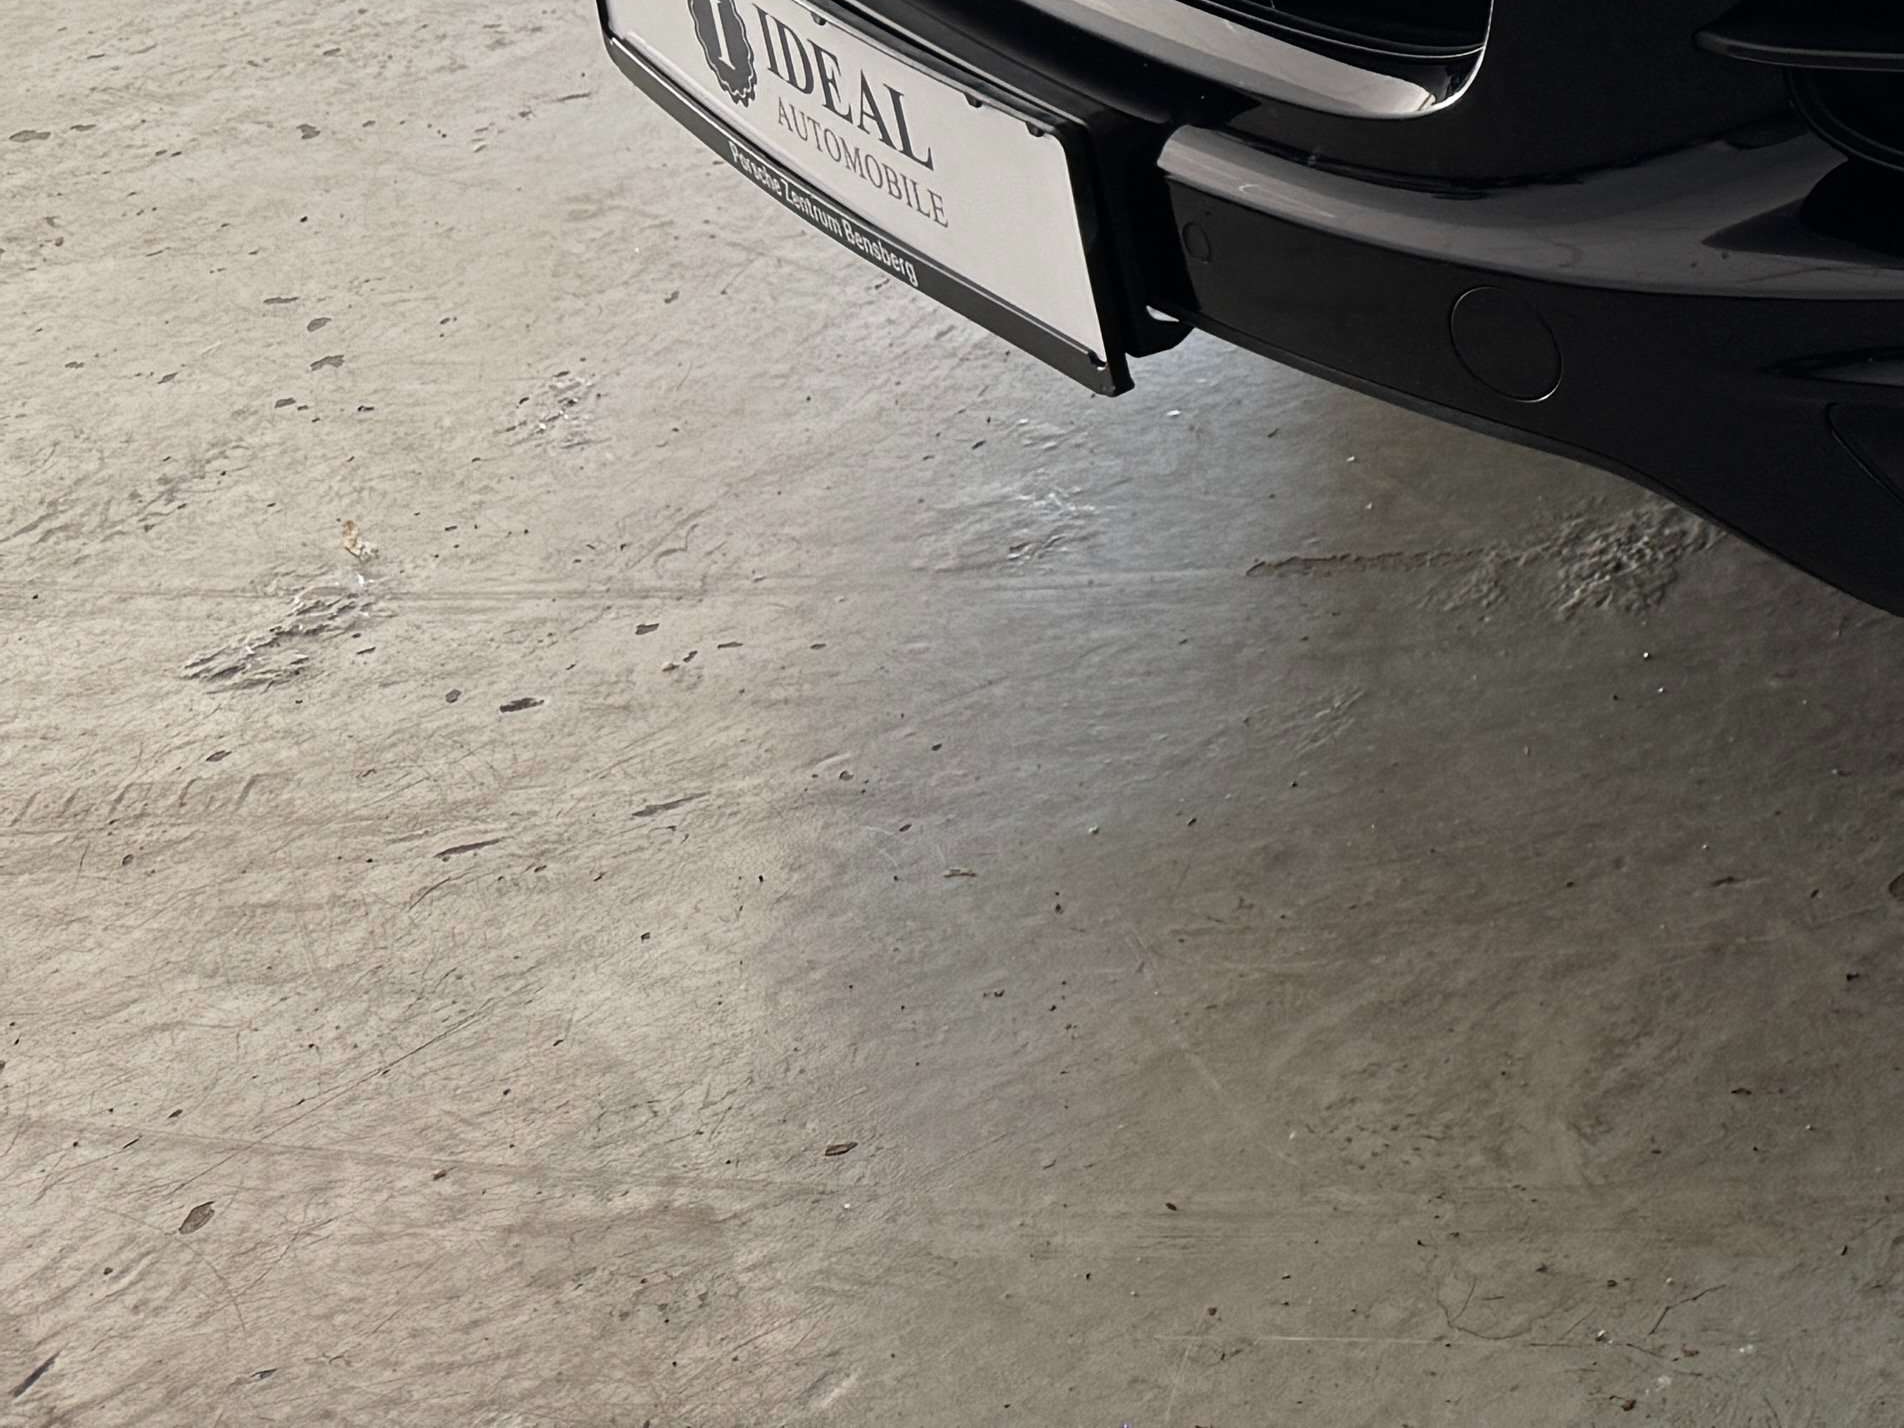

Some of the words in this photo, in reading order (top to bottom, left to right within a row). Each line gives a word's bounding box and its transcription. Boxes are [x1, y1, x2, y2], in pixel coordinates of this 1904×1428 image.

[750, 1, 936, 172] IDEAL
[729, 141, 783, 197] Porsche
[779, 177, 843, 238] Zentrum
[844, 218, 918, 288] Bensberg
[776, 96, 950, 229] AUTOMOBILE
